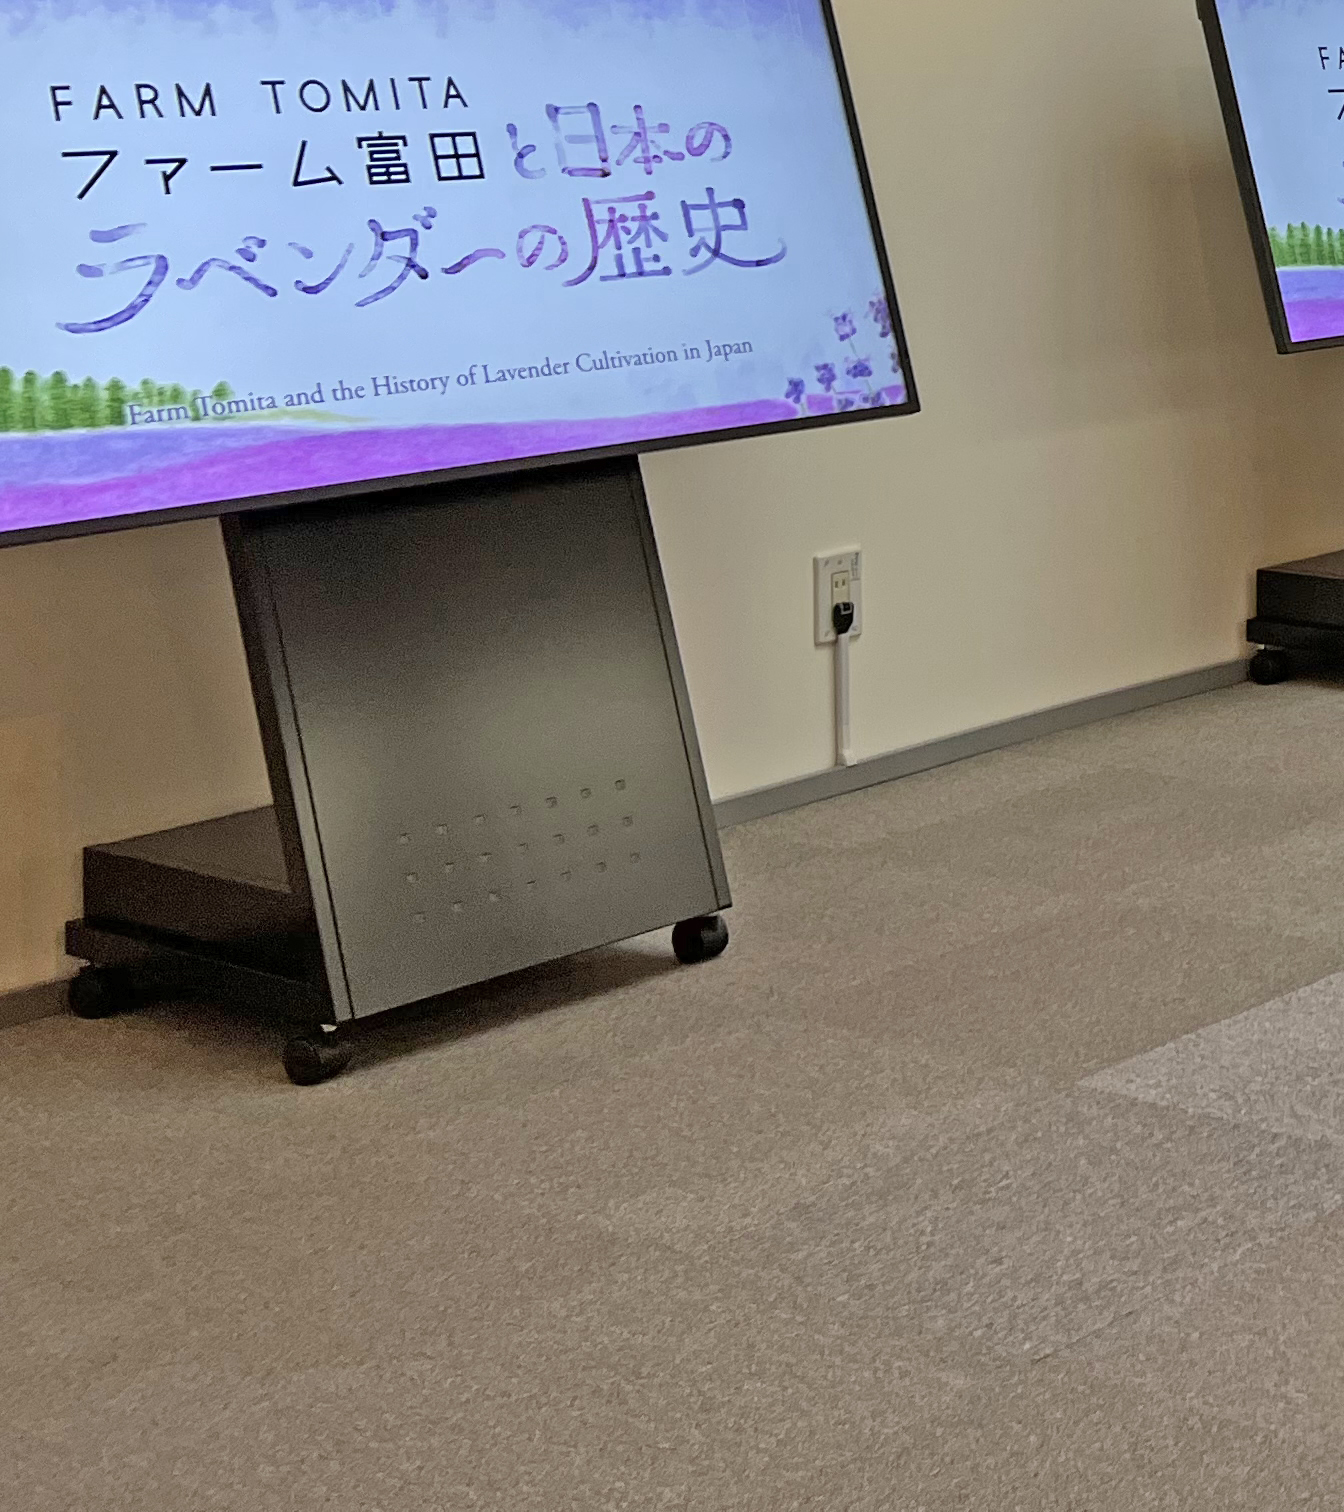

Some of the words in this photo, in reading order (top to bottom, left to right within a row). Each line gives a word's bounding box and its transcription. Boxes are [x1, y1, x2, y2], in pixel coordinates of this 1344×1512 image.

[49, 83, 218, 122] FARM
[261, 75, 469, 115] TOMITA
[55, 187, 788, 334] ラベンダーの歴史
[128, 402, 190, 426] Farm
[194, 392, 278, 419] Tomita
[283, 382, 325, 407] and
[331, 380, 366, 402] the
[371, 374, 450, 397] History
[456, 364, 479, 388] of
[481, 356, 571, 385] Lavender
[575, 346, 678, 374] Cultivation
[683, 342, 701, 360] in
[705, 339, 753, 363] Japan
